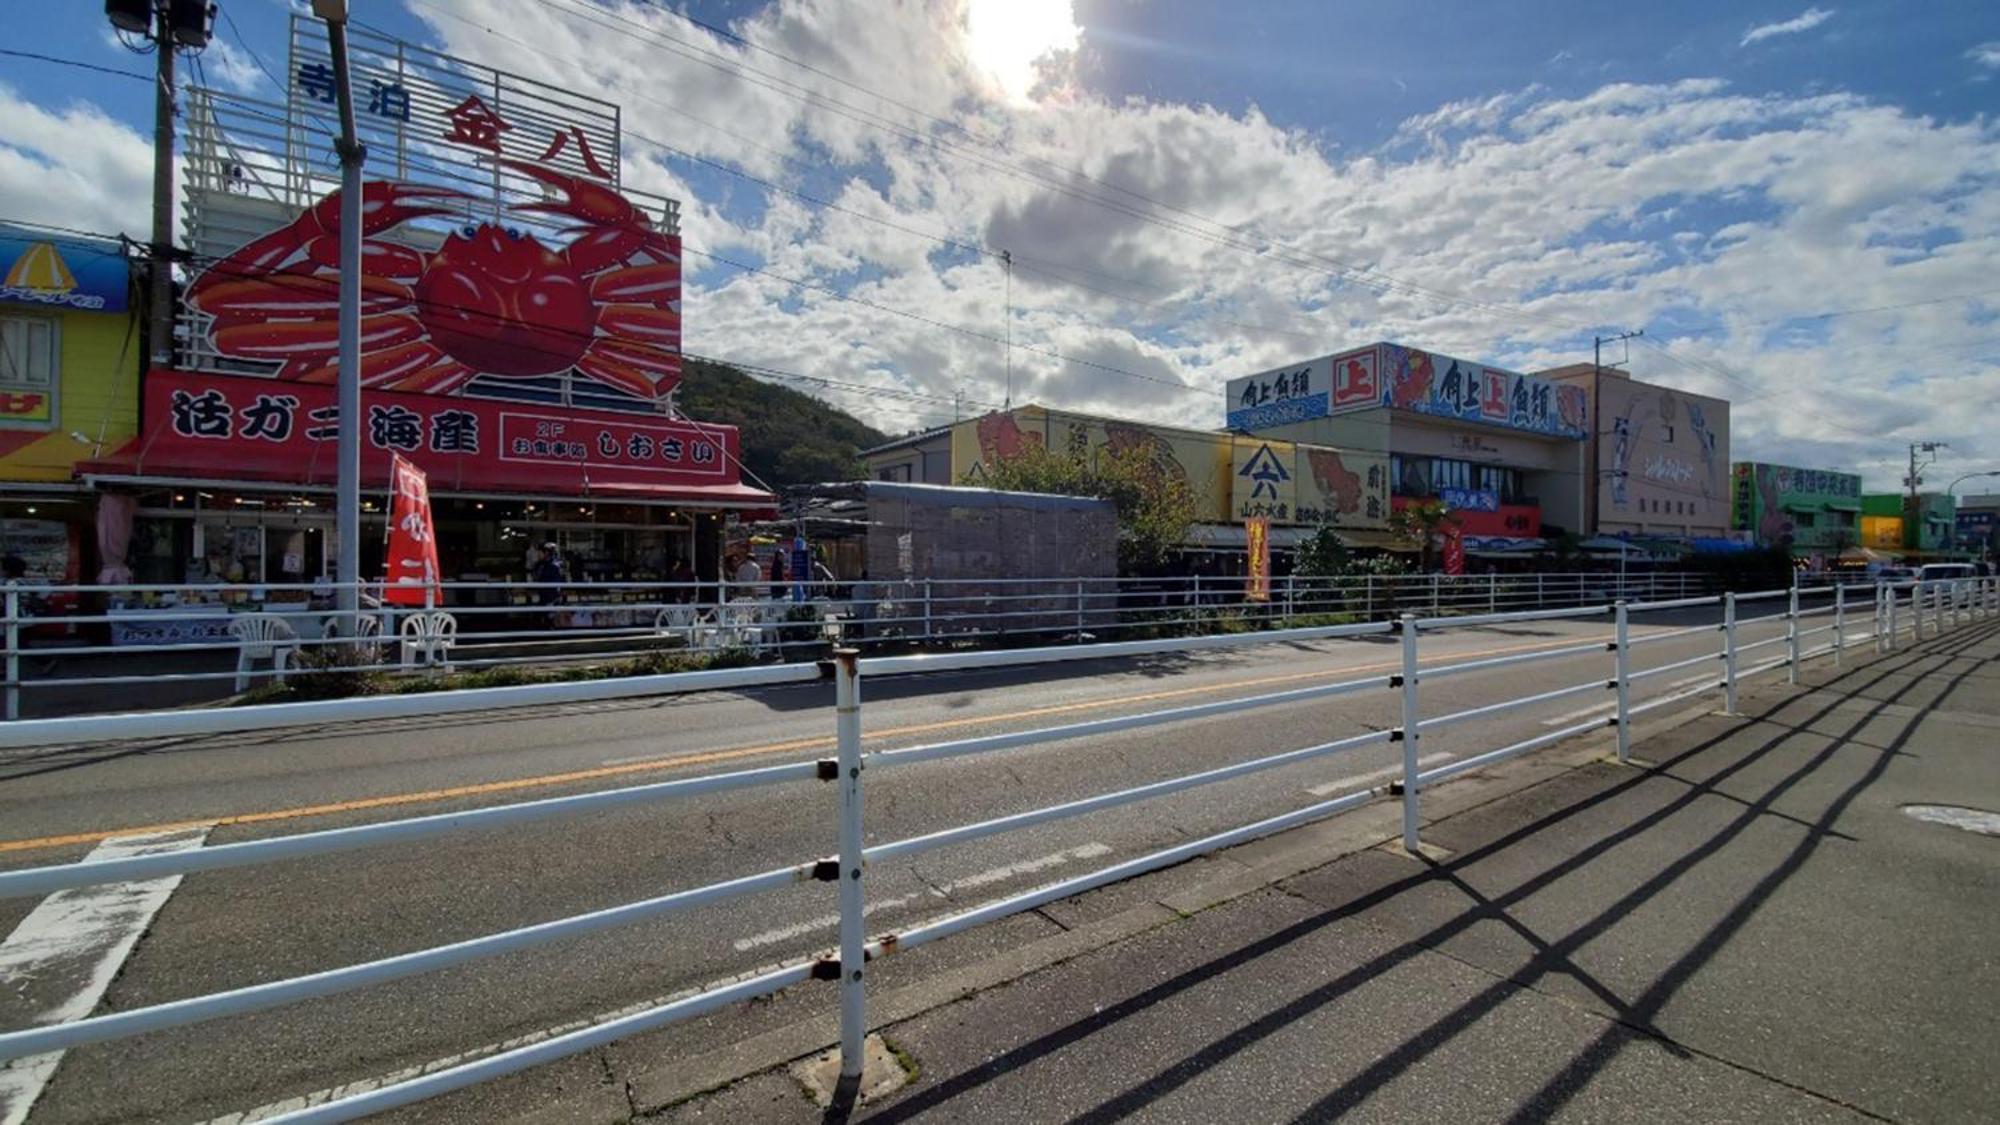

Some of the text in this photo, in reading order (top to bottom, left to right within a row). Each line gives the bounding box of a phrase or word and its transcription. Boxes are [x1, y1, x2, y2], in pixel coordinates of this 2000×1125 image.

[298, 63, 613, 179] 寺泊 金八
[172, 388, 480, 454] 活ガニ海産
[536, 421, 565, 437] 2F
[597, 431, 716, 465] しおさい
[1241, 501, 1289, 519] 山六水産
